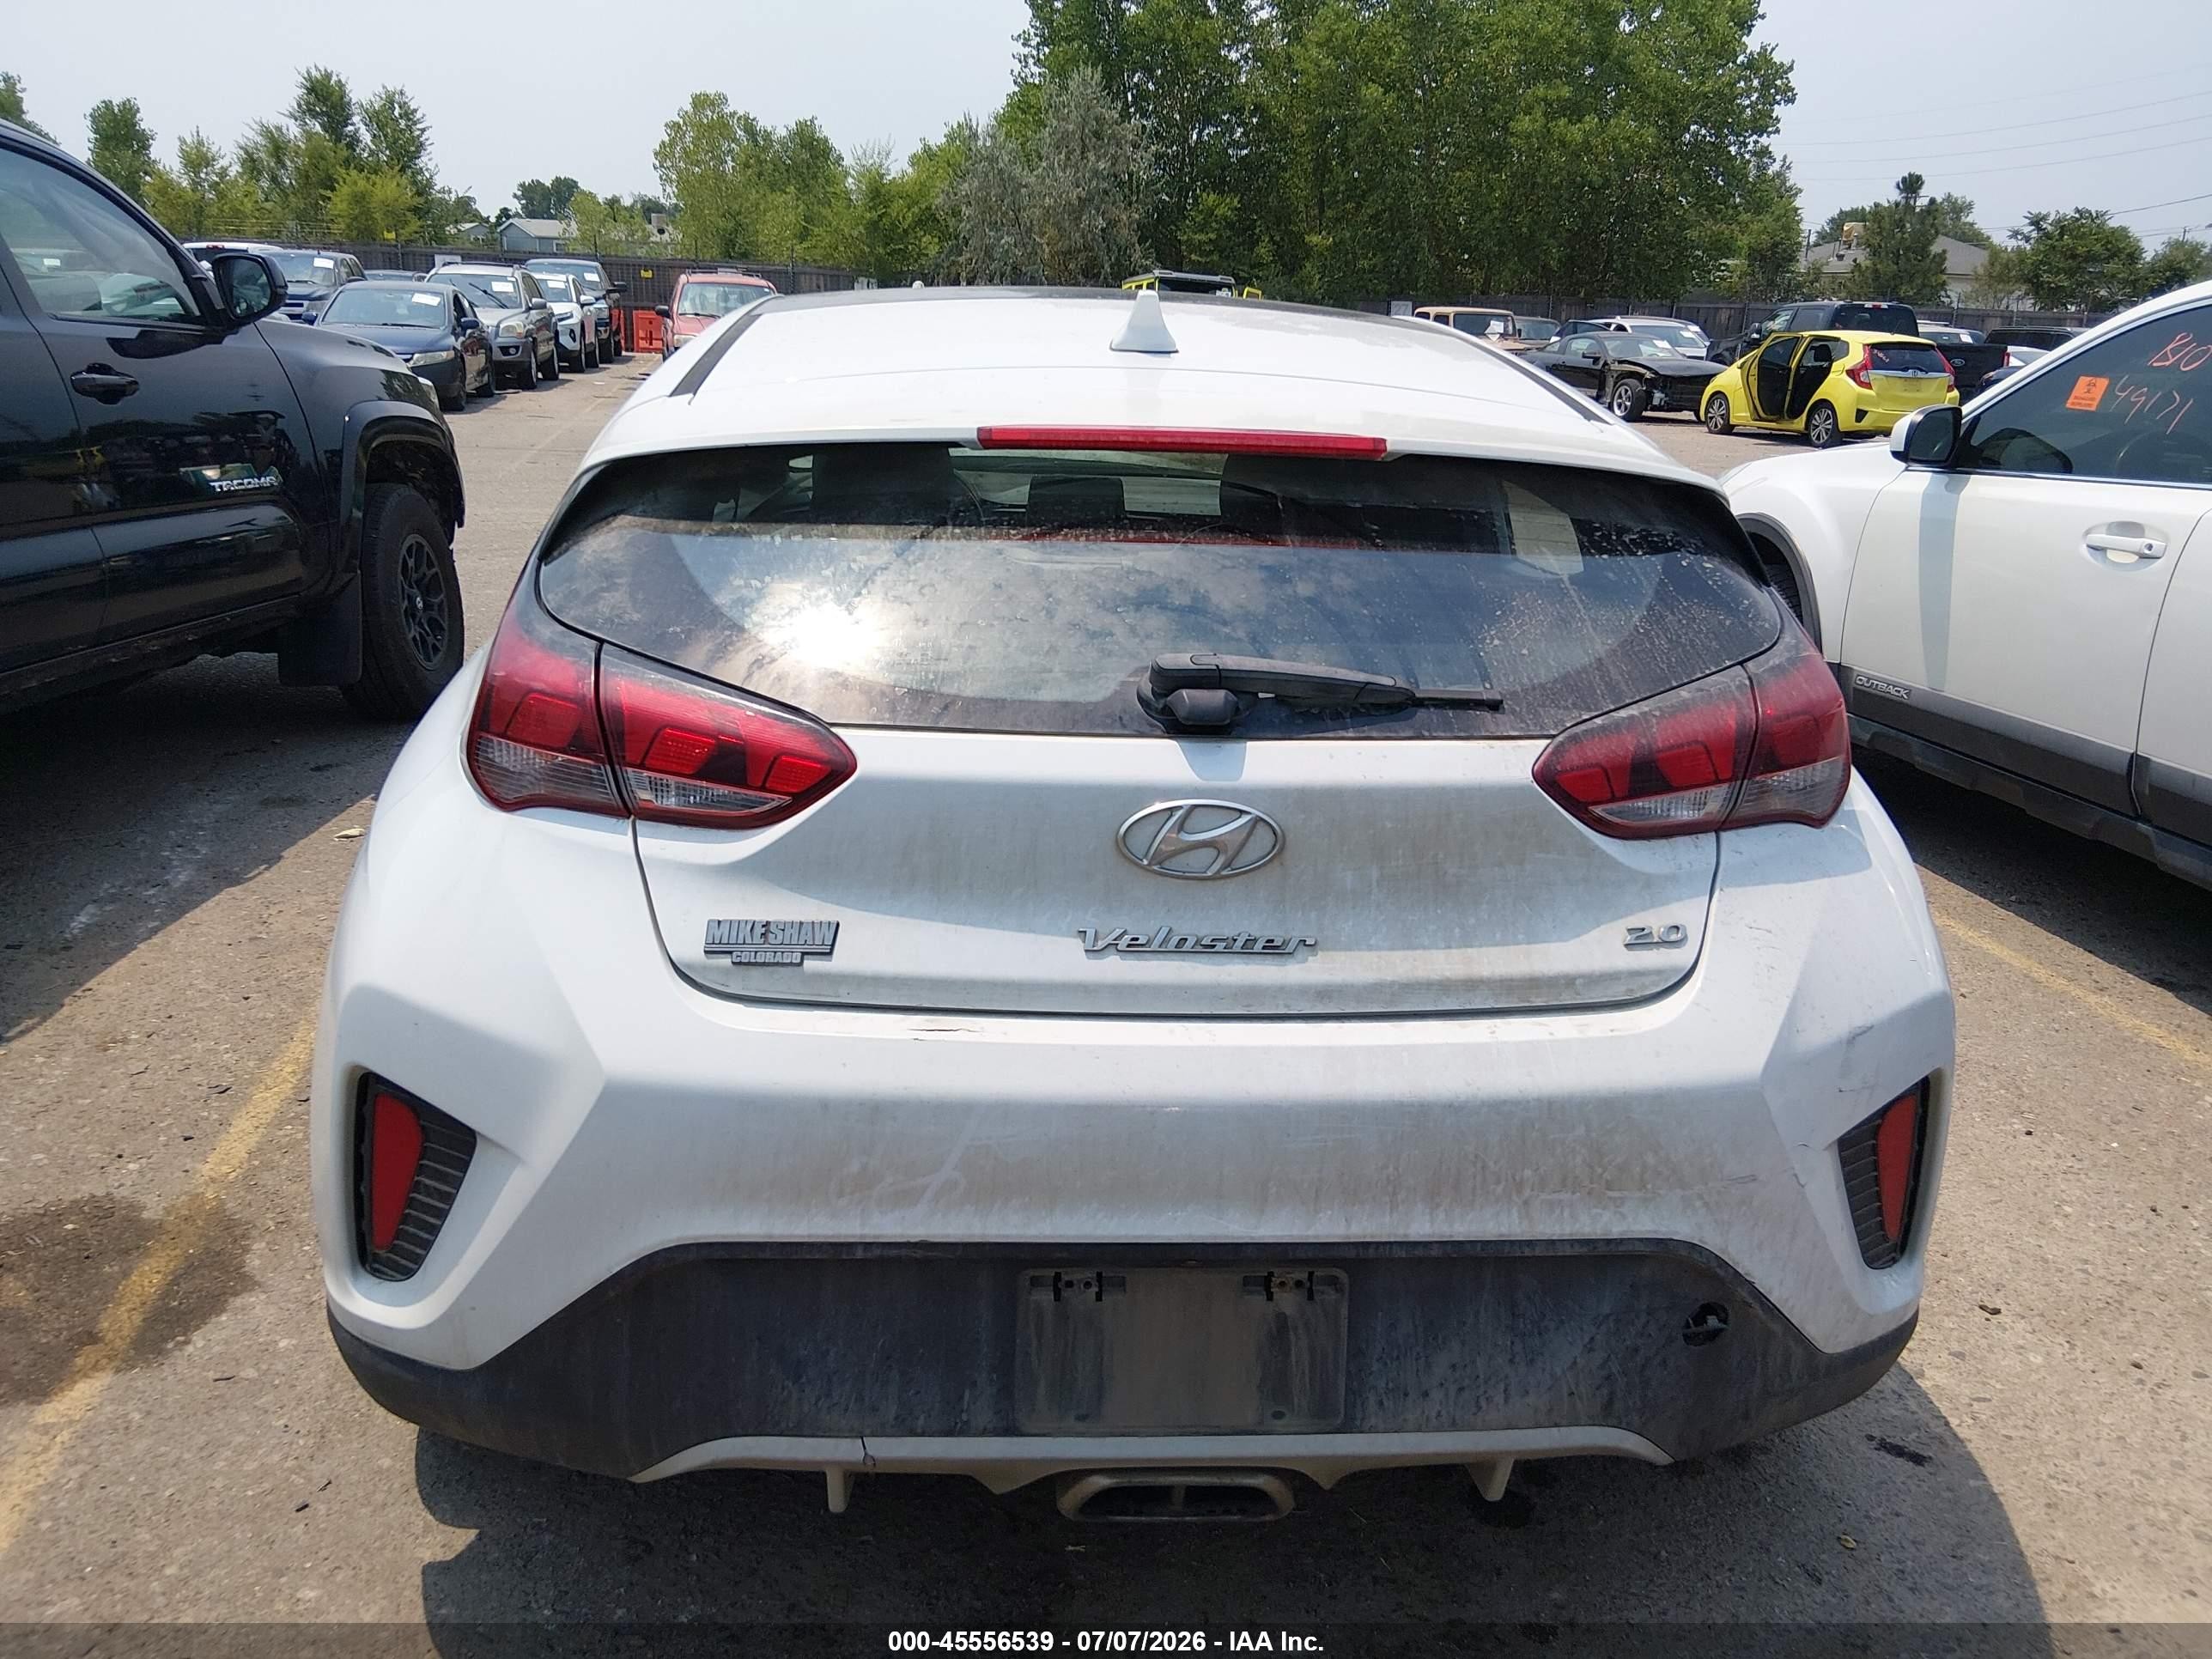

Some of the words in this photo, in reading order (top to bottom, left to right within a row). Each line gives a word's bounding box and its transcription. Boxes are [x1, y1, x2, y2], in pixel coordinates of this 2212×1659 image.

[209, 476, 279, 492] TACOMA
[1855, 675, 1911, 700] OUTBACK
[705, 919, 769, 945] MIKE
[768, 920, 839, 945] SHAW
[1078, 927, 1317, 954] Veloster
[732, 951, 803, 963] COLORADO
